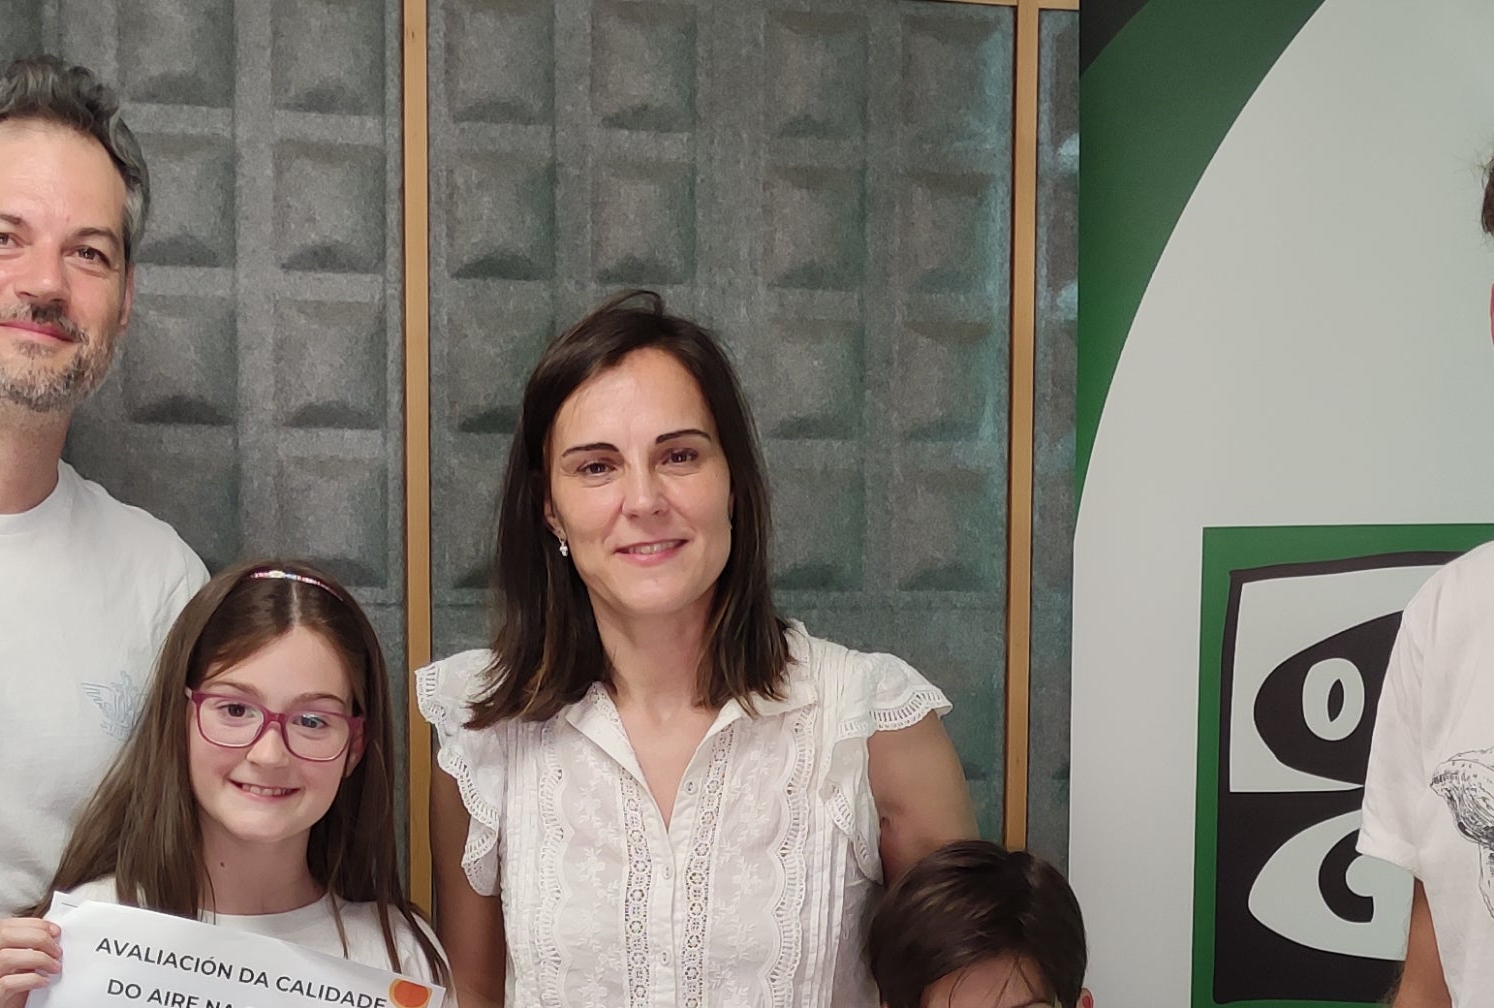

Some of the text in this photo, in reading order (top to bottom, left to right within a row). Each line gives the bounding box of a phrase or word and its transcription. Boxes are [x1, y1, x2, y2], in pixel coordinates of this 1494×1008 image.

[95, 937, 233, 980] AVALIACIÓN
[238, 967, 269, 988] DA
[107, 978, 142, 999] DO
